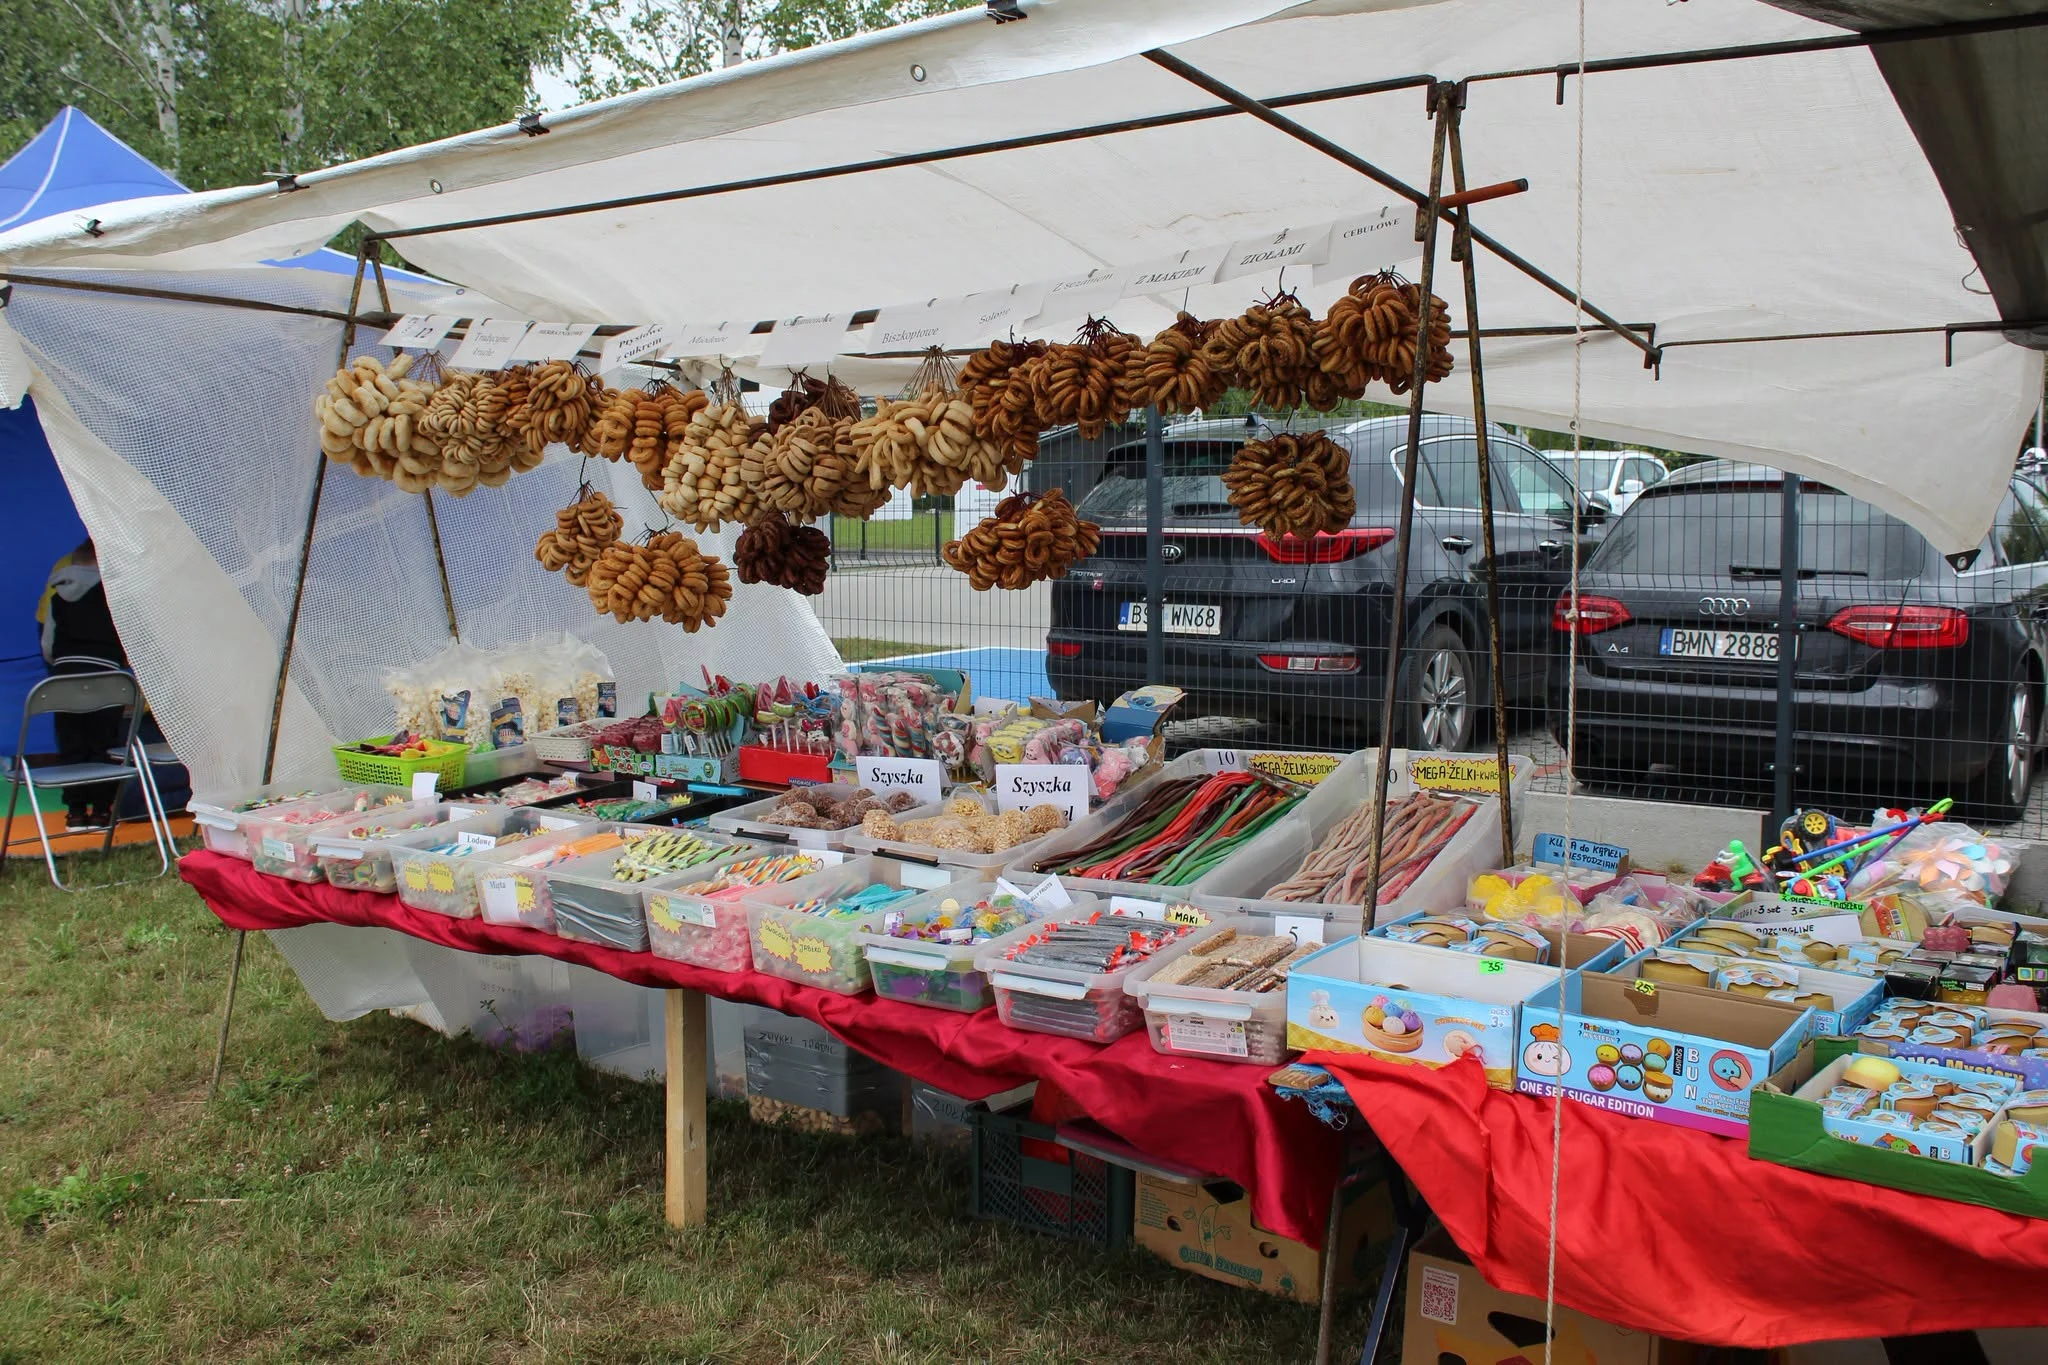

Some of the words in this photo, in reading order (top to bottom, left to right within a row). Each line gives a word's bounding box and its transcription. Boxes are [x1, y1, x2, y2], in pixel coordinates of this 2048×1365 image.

[1343, 217, 1401, 239] CEBULOWE
[1239, 243, 1306, 266] ZIOŁAMI
[1063, 272, 1113, 290] sezamem
[1143, 265, 1207, 284] MAKIEM
[618, 326, 664, 349] Ptysiowe
[882, 326, 940, 344] Biszkoptowe
[623, 337, 663, 360] cukrem
[1171, 606, 1216, 628] WN68
[1672, 631, 1718, 656] BMN
[1217, 750, 1236, 766] 10
[871, 767, 924, 787] Szyszka
[1012, 776, 1072, 797] Szyszka
[466, 835, 492, 847] Lodowe
[1548, 836, 1577, 850] KUA
[1579, 844, 1590, 853] do
[1174, 911, 1199, 925] MAKI
[1490, 1009, 1511, 1017] AGES
[1816, 1015, 1834, 1024] AGES
[1673, 1047, 1684, 1076] SQUISHY
[1519, 1080, 1543, 1095] ONE
[1567, 1090, 1606, 1109] SUGAR
[1607, 1097, 1655, 1119] EDITION
